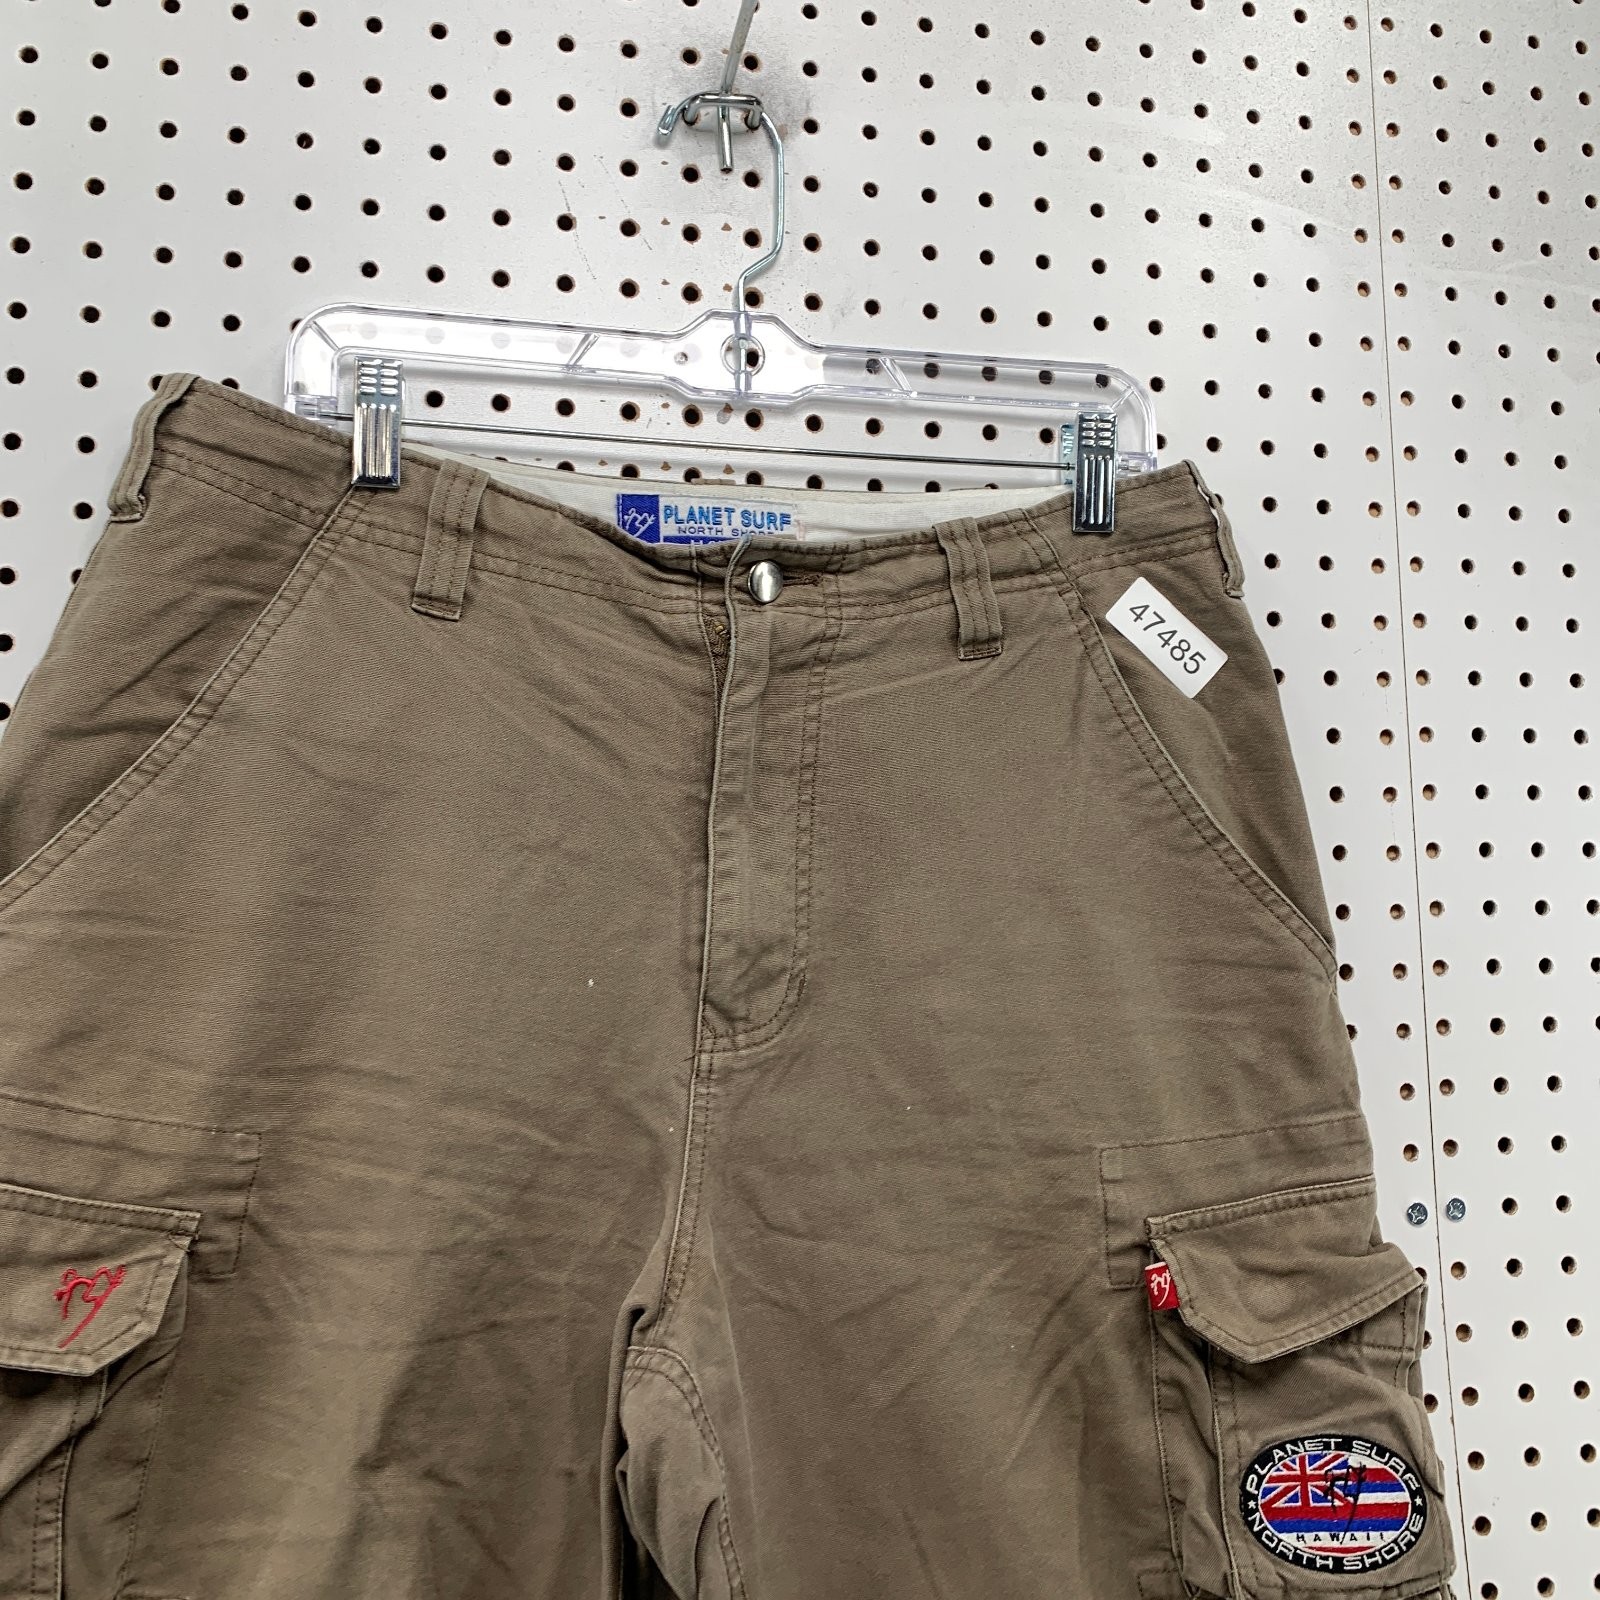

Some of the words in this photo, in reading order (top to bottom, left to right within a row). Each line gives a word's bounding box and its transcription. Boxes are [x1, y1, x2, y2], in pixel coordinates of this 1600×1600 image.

[663, 505, 735, 526] PLANET
[741, 509, 791, 531] SURF
[678, 526, 723, 536] NORTH
[1129, 604, 1206, 674] 47485
[1246, 1438, 1342, 1494] PLANET
[1351, 1440, 1421, 1490] SURF
[1248, 1512, 1333, 1570] NORTH
[1343, 1512, 1424, 1571] SHORE
[1296, 1532, 1385, 1545] HAWAII
